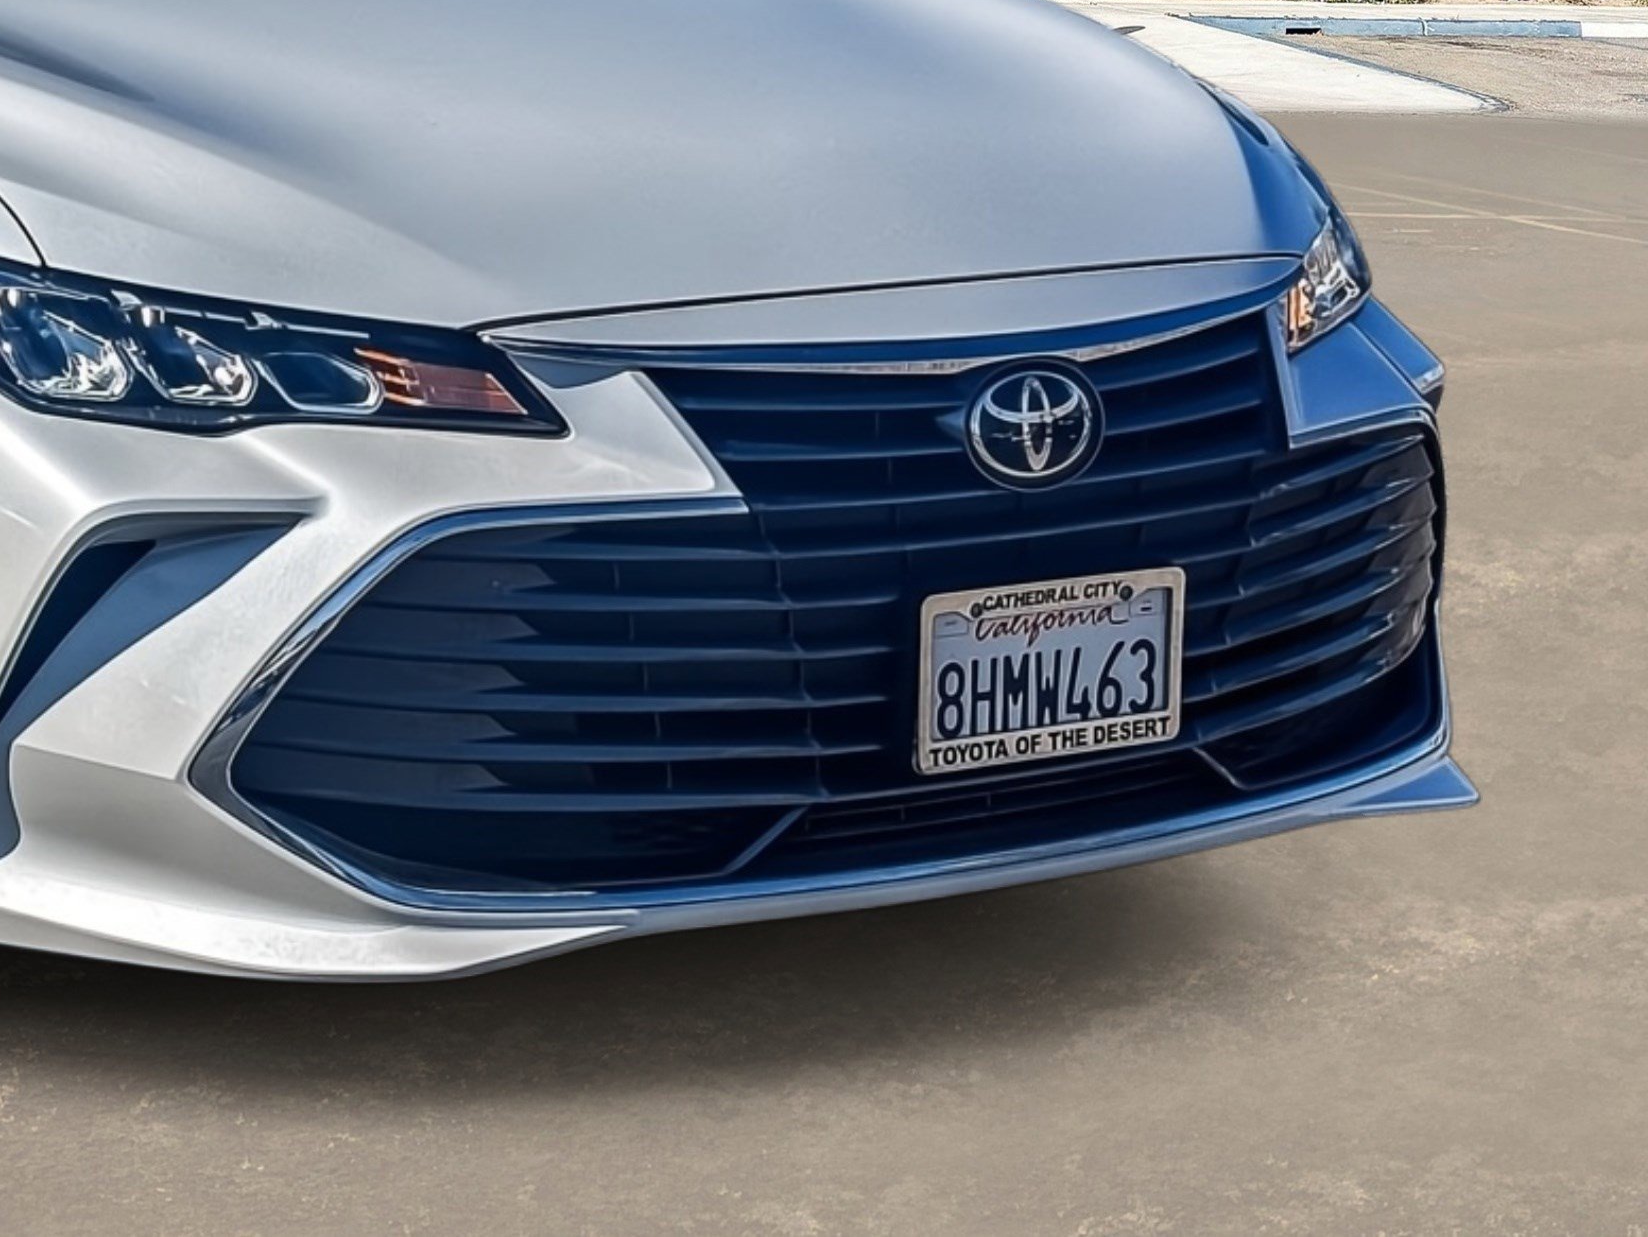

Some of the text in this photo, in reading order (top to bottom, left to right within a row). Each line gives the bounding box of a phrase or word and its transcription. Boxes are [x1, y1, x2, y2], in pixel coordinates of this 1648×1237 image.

[982, 580, 1123, 613] CATHEDRAL CITY
[973, 605, 1130, 647] California
[936, 638, 1157, 739] 8HMW463
[929, 715, 1171, 767] TOYOTA OF THE DESERT
